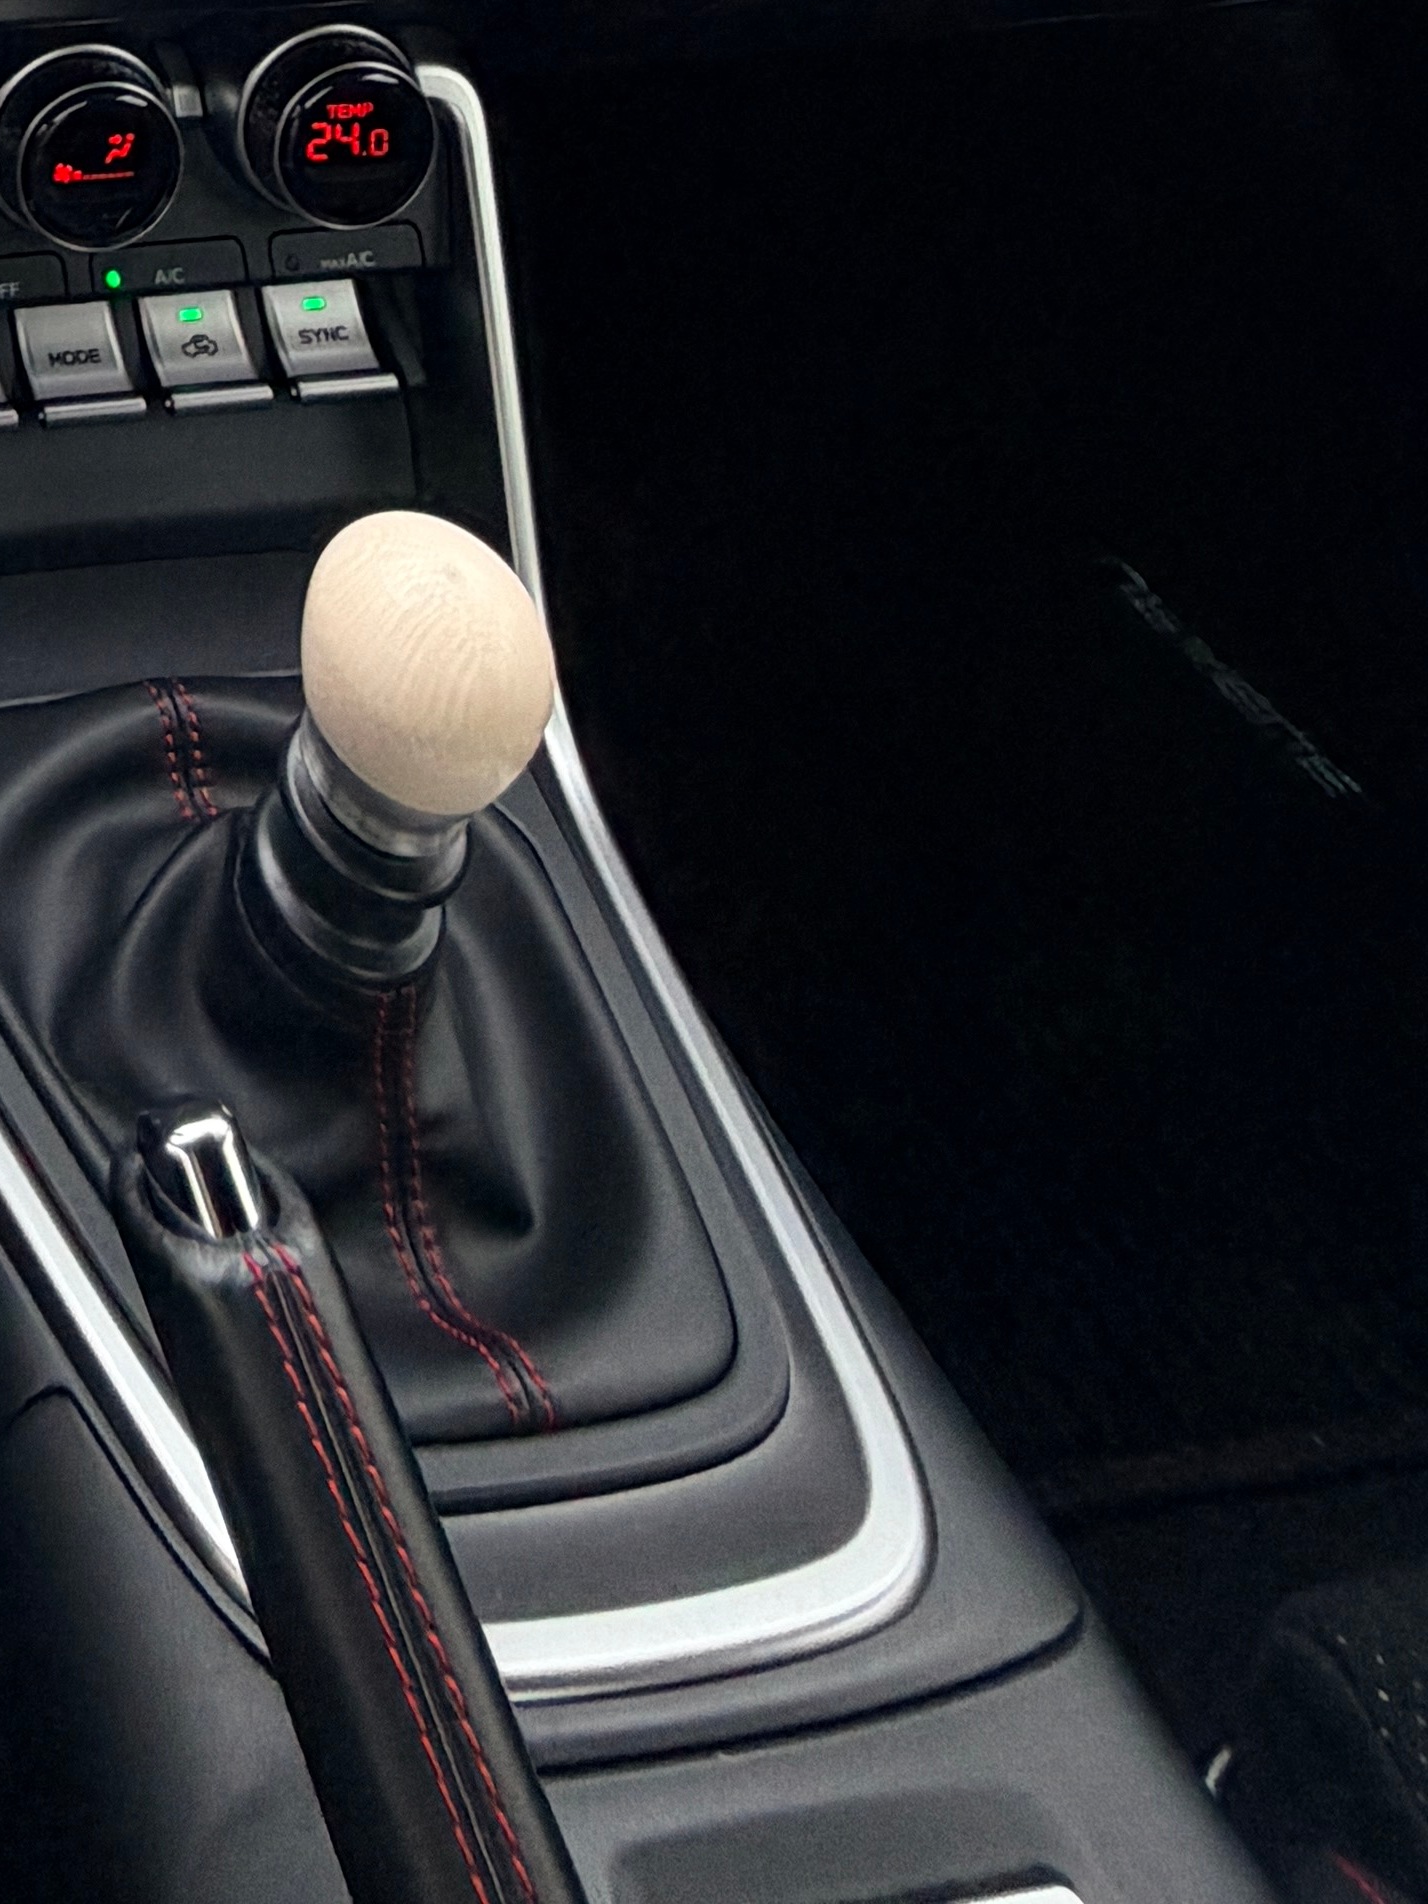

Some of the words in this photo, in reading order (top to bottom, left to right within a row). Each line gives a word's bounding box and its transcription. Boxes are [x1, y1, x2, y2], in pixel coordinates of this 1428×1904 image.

[326, 101, 374, 120] TEMP
[306, 122, 390, 162] 24.0
[154, 266, 186, 286] A/C
[298, 325, 350, 345] SYNC
[47, 346, 102, 369] MODE
